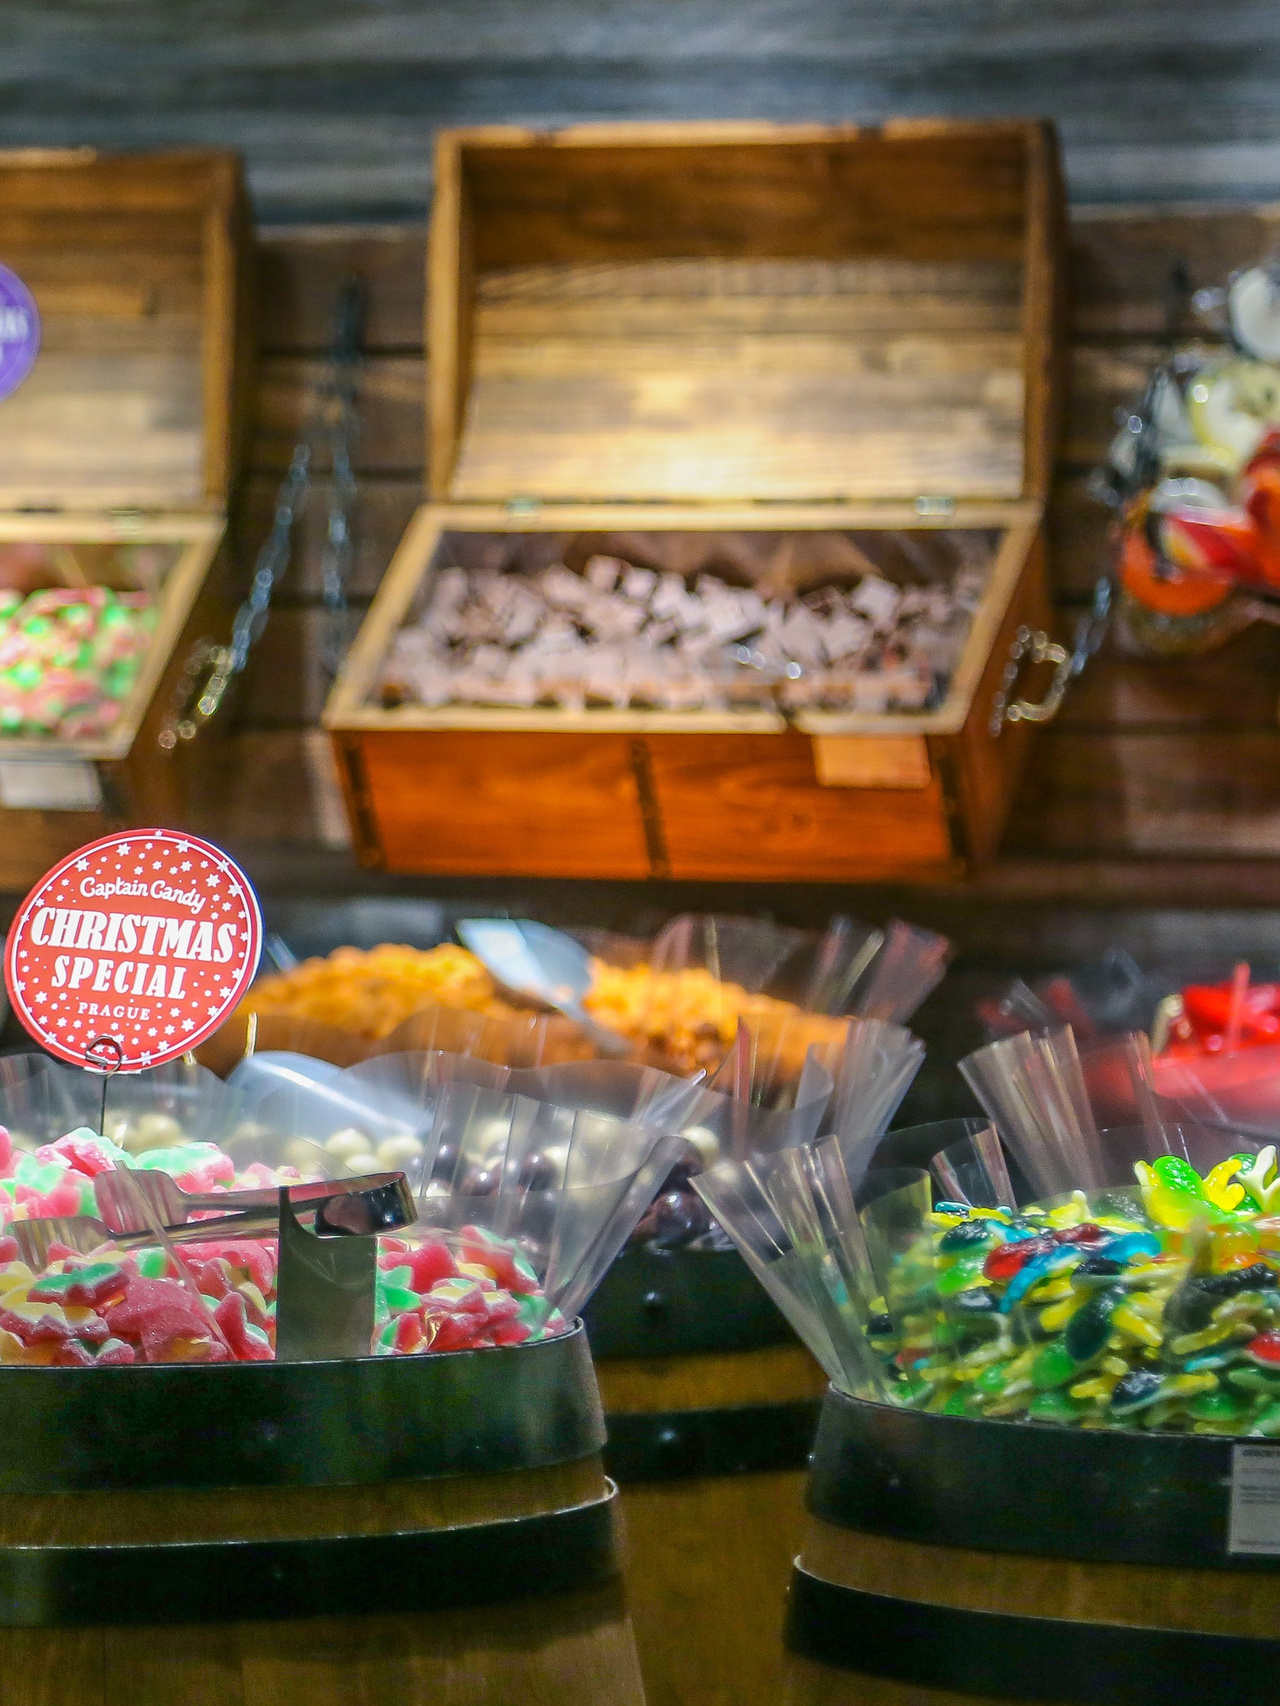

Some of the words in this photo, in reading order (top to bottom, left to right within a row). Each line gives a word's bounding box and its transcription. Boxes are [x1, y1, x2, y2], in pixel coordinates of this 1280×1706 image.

[80, 877, 148, 900] Captain
[151, 880, 206, 914] Candy
[31, 907, 237, 963] CHRISTMAS
[51, 955, 186, 999] SPECIAL
[78, 1002, 151, 1021] PRAGUE
